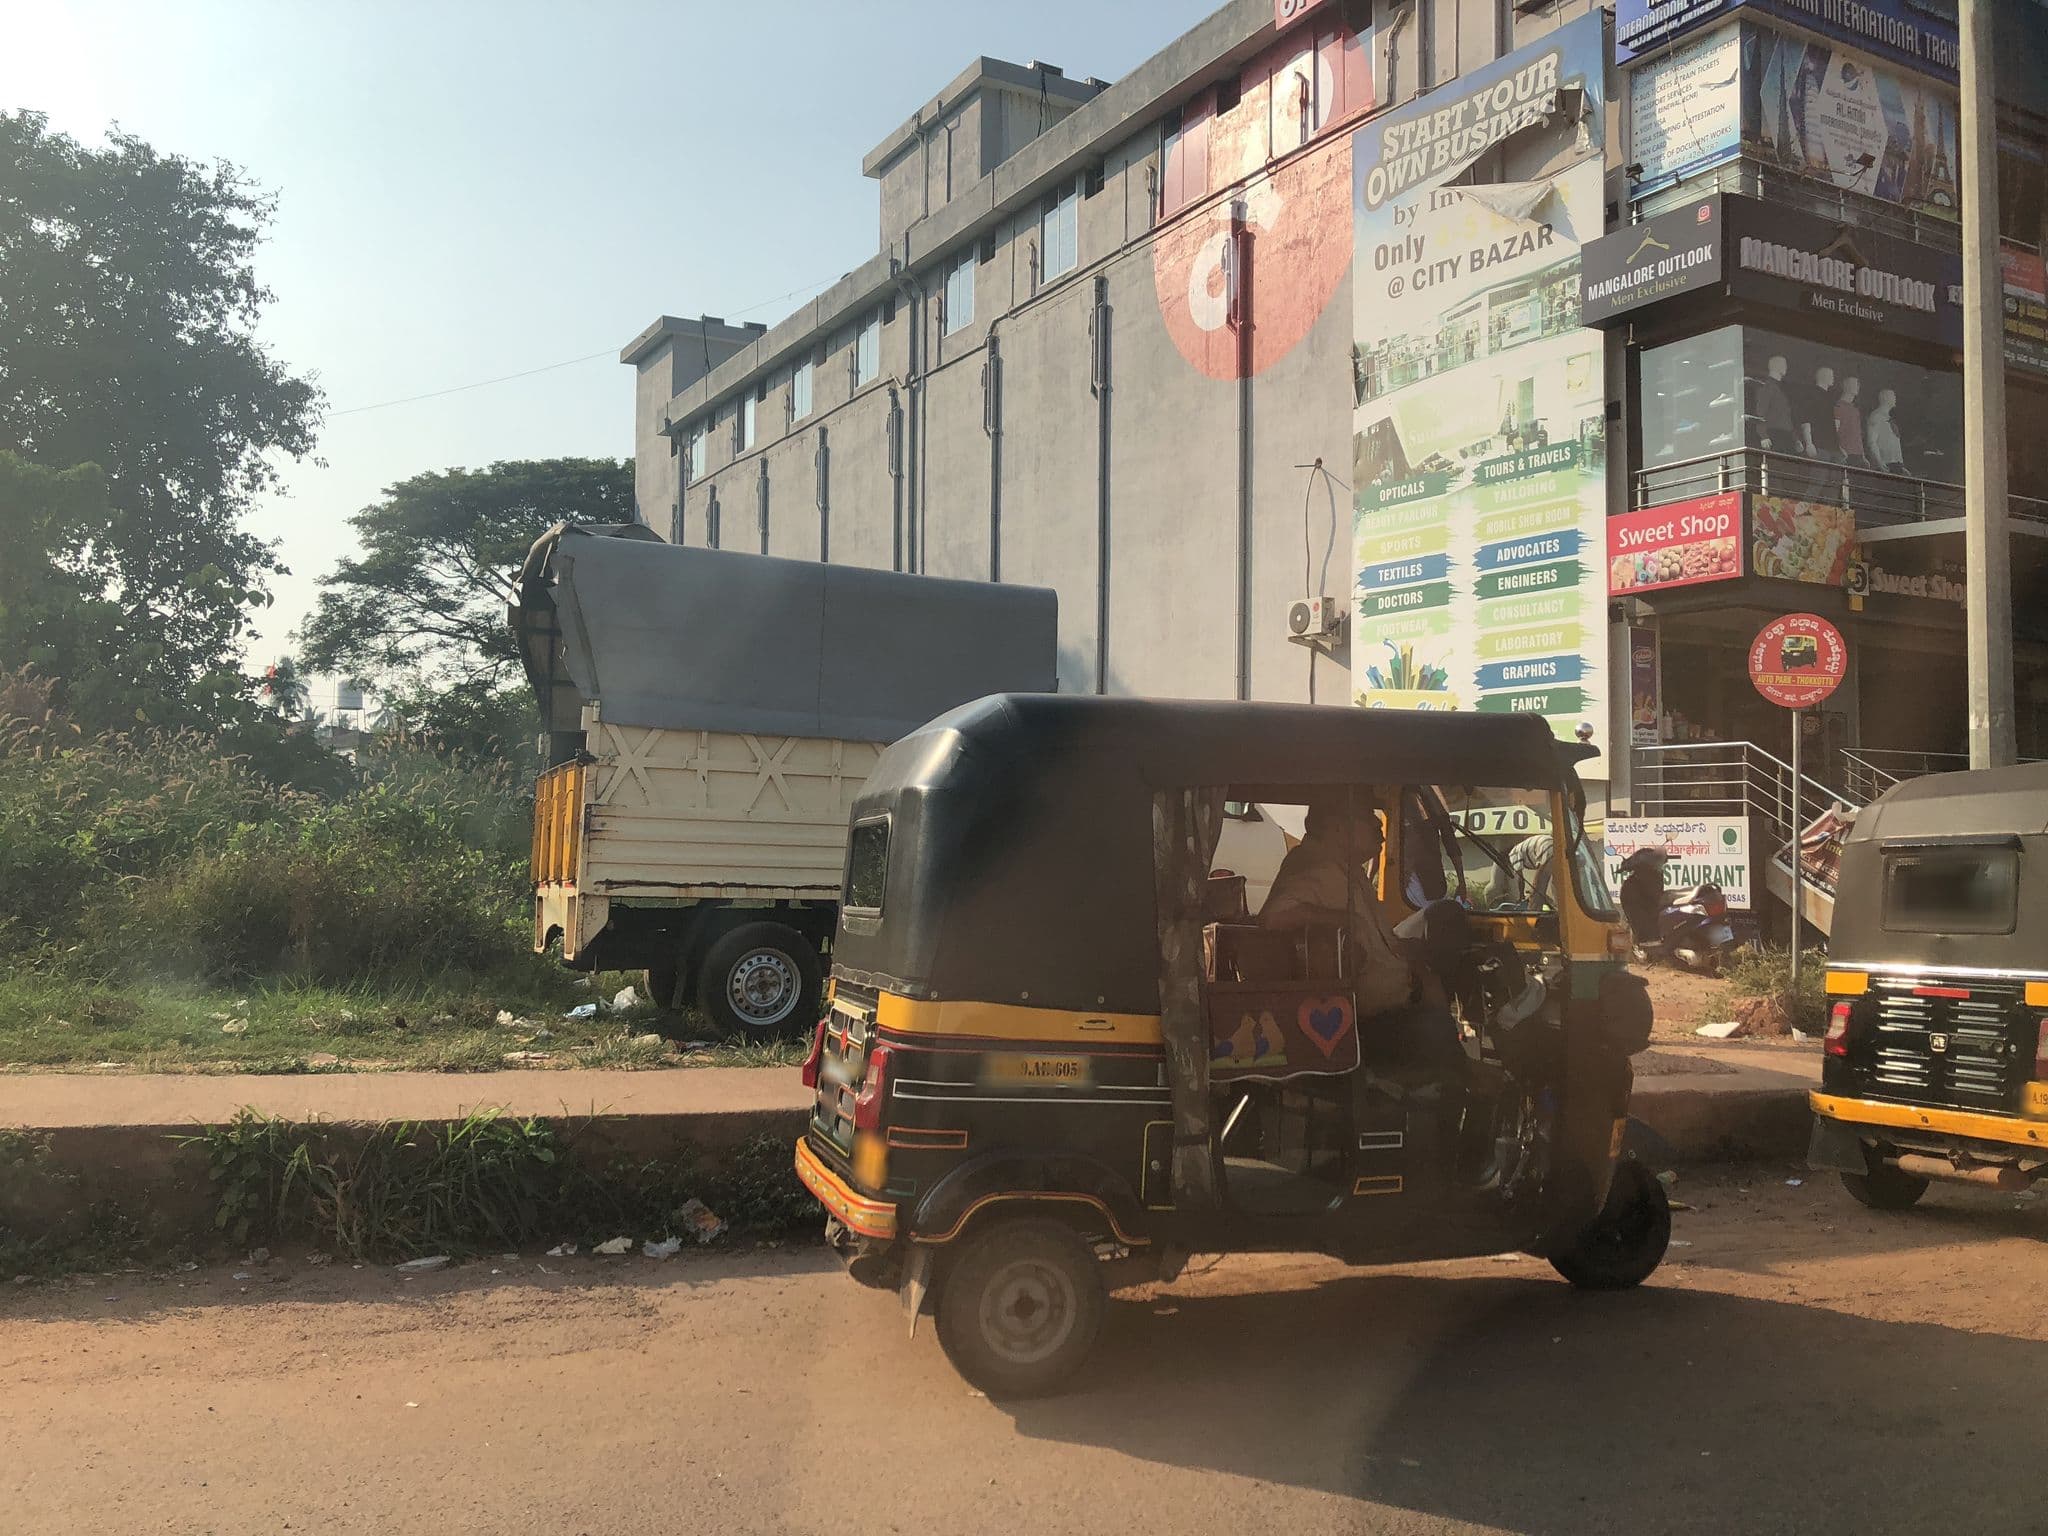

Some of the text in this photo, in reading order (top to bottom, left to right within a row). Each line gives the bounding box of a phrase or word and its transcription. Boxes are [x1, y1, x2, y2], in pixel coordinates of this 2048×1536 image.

[1383, 52, 1559, 161] START YOUR
[1367, 147, 1431, 205] OWN
[1392, 203, 1420, 228] by
[1374, 234, 1426, 272] Only
[1388, 223, 1554, 299] @ CITY BAZAR
[1588, 244, 1713, 302] MANGALORE OUTLOOK
[1740, 236, 1855, 293] MANGALORE
[1855, 266, 1937, 313] OUTLOOK
[1610, 274, 1688, 308] Men Exclusive
[1812, 292, 1885, 323] Men Exclusive
[1484, 446, 1571, 479] TOURS & TRAVELS
[1379, 480, 1425, 502] OPTICALS
[1494, 479, 1557, 504] TAILORING
[1618, 513, 1730, 548] Sweet Shop
[1380, 535, 1421, 554] SPORTS
[1496, 538, 1560, 562] ADVOCATES
[1378, 563, 1423, 582] TEXTILES
[1497, 568, 1558, 591] ENGINEERS
[1869, 567, 1928, 598] Sweet
[1378, 590, 1424, 610] DOCTORS
[1492, 599, 1565, 621] CONSULTANCY
[1495, 631, 1563, 652] LABORATORY
[1502, 661, 1557, 681] GRAPHICS
[1757, 674, 1774, 684] AUTO
[1774, 675, 1793, 684] PARK
[1510, 696, 1549, 712] FANCY
[1607, 821, 1649, 834] ಹೋಟೆಲ್
[1663, 864, 1746, 888] STAURANT
